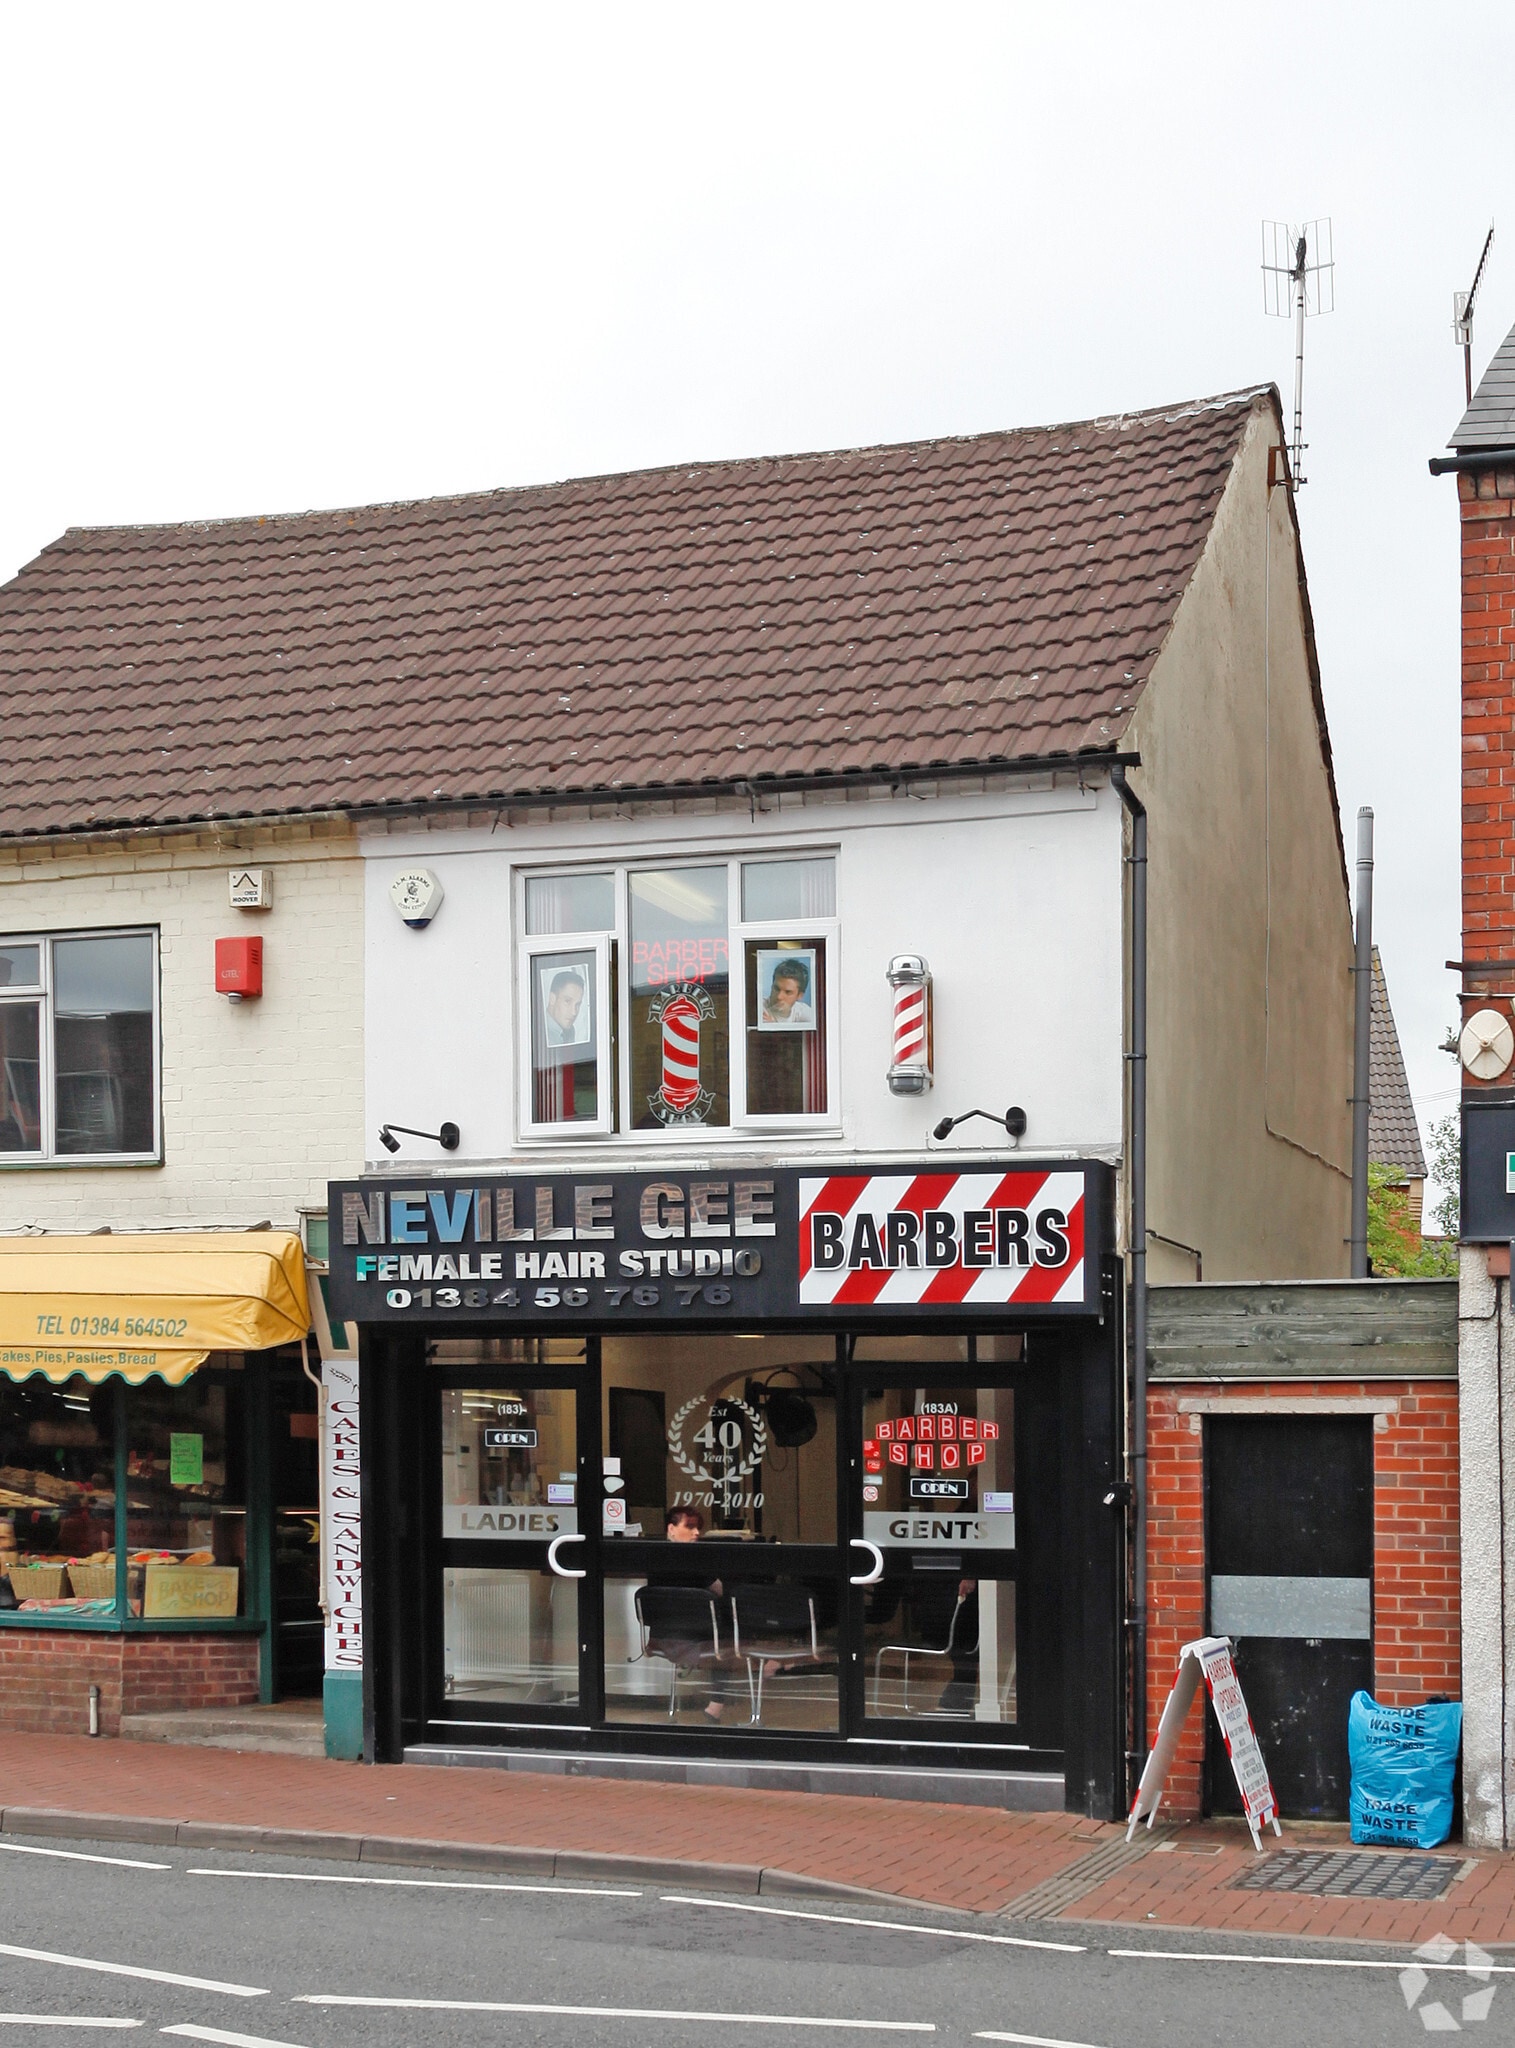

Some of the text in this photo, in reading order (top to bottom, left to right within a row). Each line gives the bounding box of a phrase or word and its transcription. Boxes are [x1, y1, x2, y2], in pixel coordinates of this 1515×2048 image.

[409, 875, 430, 888] ALARMS
[633, 938, 729, 964] BARBER
[647, 961, 717, 986] SHOP
[652, 983, 711, 1011] BARBER
[658, 1107, 702, 1124] SHOP
[342, 1180, 777, 1245] NEVILLE GEE
[810, 1207, 1070, 1270] BARBERS
[356, 1249, 762, 1282] FEMALE HAIR STUDIO
[386, 1284, 731, 1309] 01384 56 76 76
[37, 1315, 188, 1337] TEL 01384 564502
[708, 1406, 728, 1417] Est
[920, 1402, 958, 1415] (183A)
[693, 1421, 742, 1450] 40
[878, 1417, 997, 1438] BARBER
[494, 1433, 530, 1444] OPEN
[703, 1452, 734, 1463] Years
[892, 1445, 983, 1468] SHOP
[920, 1482, 958, 1495] OPEN
[672, 1491, 765, 1509] 1970-2010
[461, 1513, 559, 1532] LADIES
[889, 1520, 989, 1540] GENTS
[330, 1401, 363, 1667] CAKES & SANDWICHES
[181, 1591, 229, 1608] SHOP
[1207, 1656, 1232, 1684] BARBERS
[1370, 1718, 1425, 1737] WASTE
[1364, 1797, 1417, 1815] TRADE
[1361, 1813, 1418, 1831] WASTE
